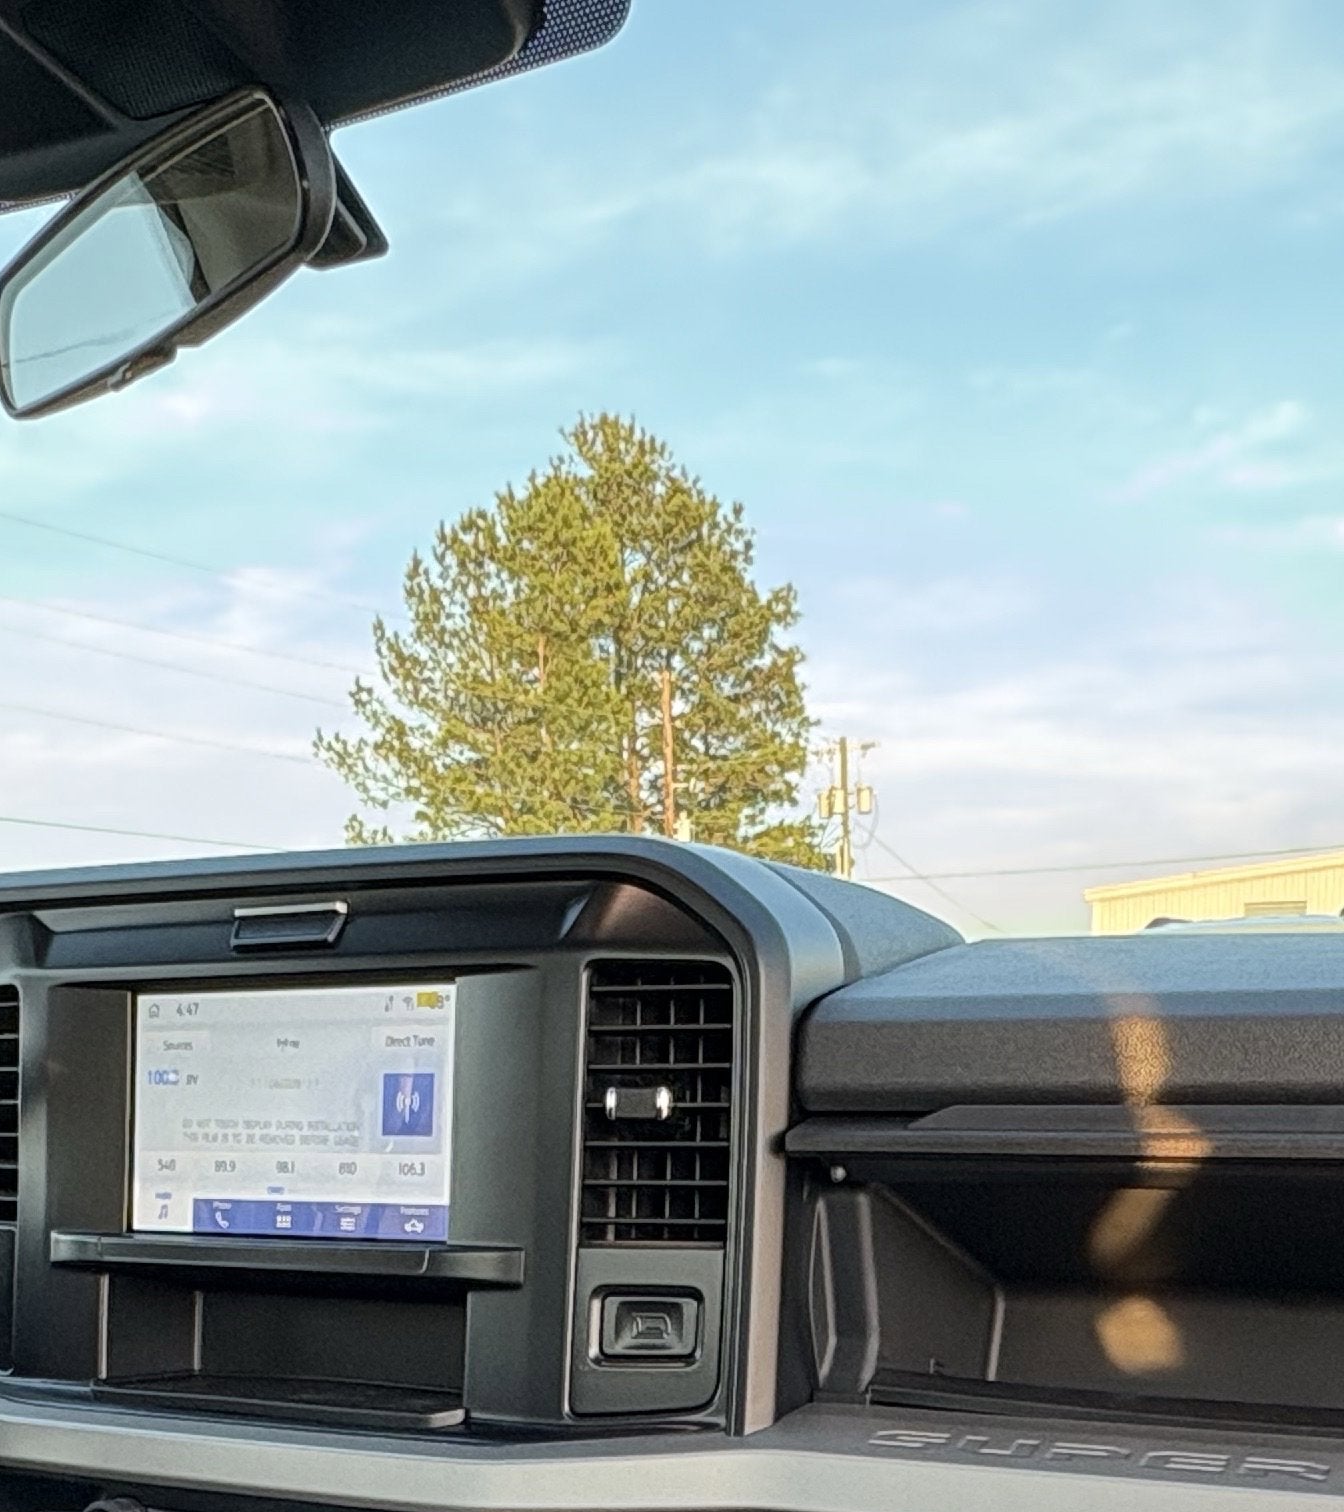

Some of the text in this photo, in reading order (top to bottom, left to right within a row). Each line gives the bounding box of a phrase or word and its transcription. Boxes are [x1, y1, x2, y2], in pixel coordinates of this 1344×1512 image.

[385, 1034, 435, 1048] Direct Tune
[214, 1160, 236, 1173] 89.9
[276, 1160, 296, 1174] 98.1
[399, 1161, 426, 1176] 106.3
[867, 1429, 1332, 1482] SUPER
